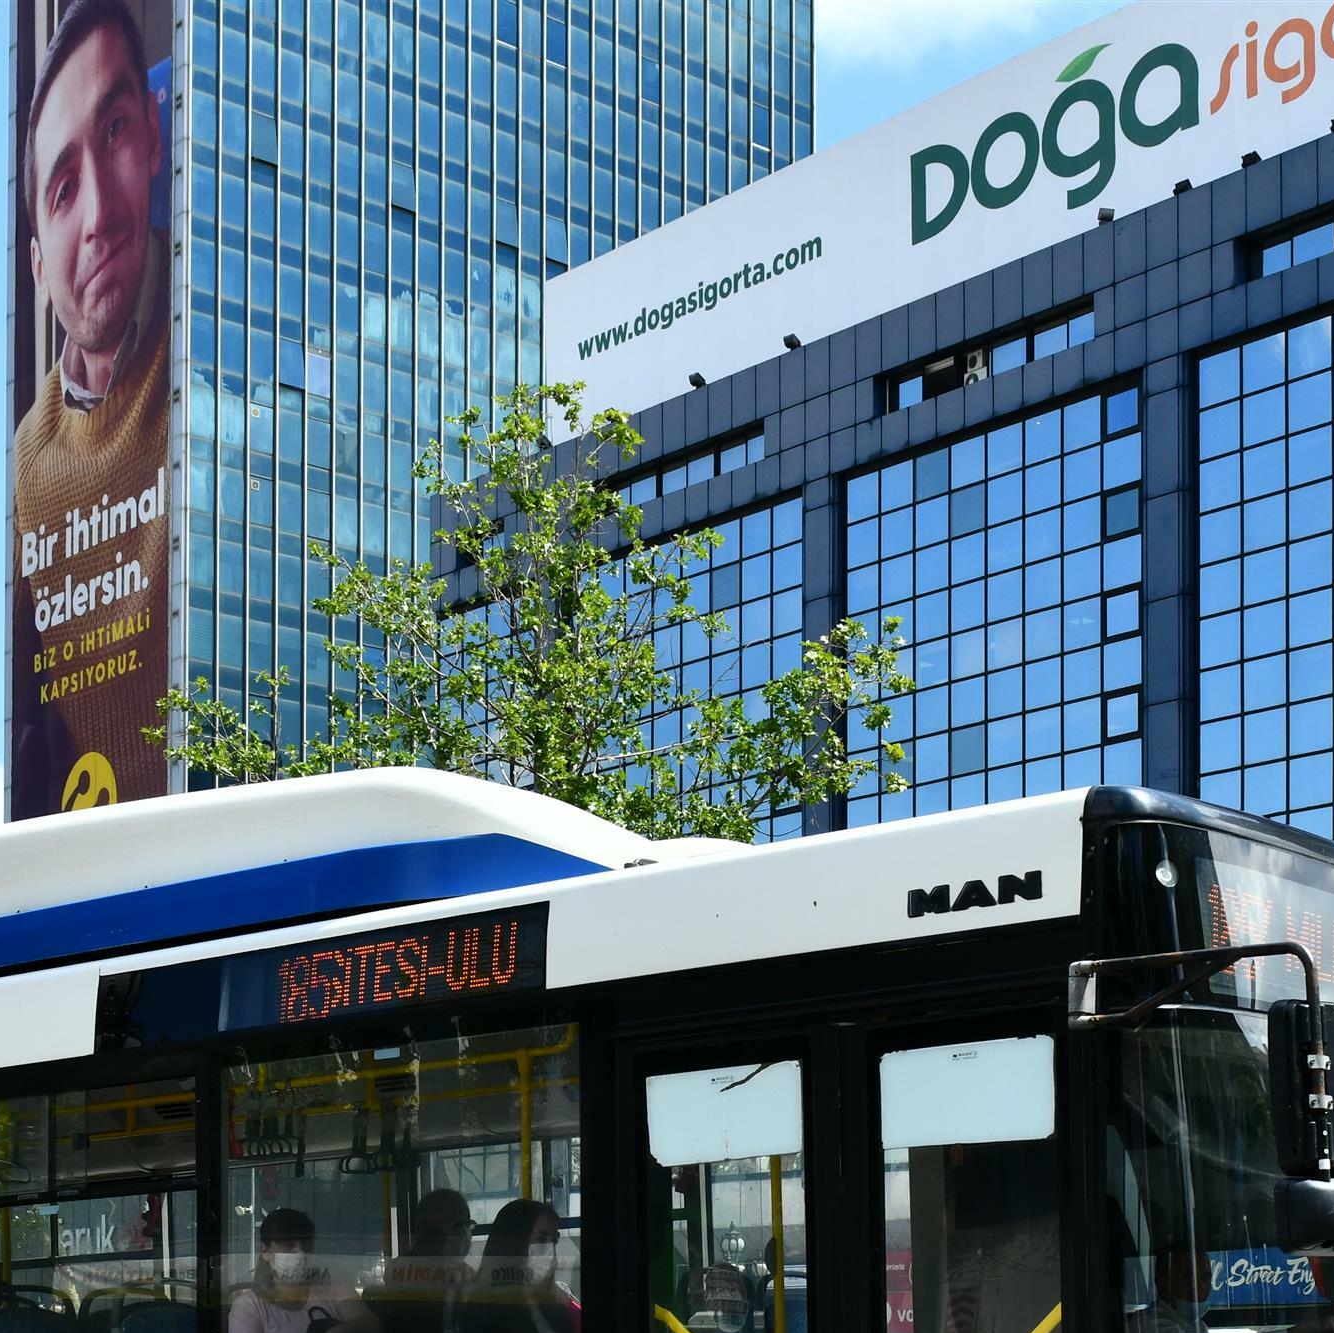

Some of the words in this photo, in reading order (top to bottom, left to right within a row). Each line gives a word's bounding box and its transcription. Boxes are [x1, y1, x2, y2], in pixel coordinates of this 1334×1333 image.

[577, 236, 823, 361] www.dogasigorta.com
[21, 523, 58, 578] Bir
[65, 466, 165, 559] ihtimal
[34, 551, 149, 633] özlersin.
[40, 649, 143, 705] KAPSIYORUZ.
[63, 641, 74, 661] O
[907, 870, 1043, 918] MAN
[1227, 1257, 1283, 1288] Street
